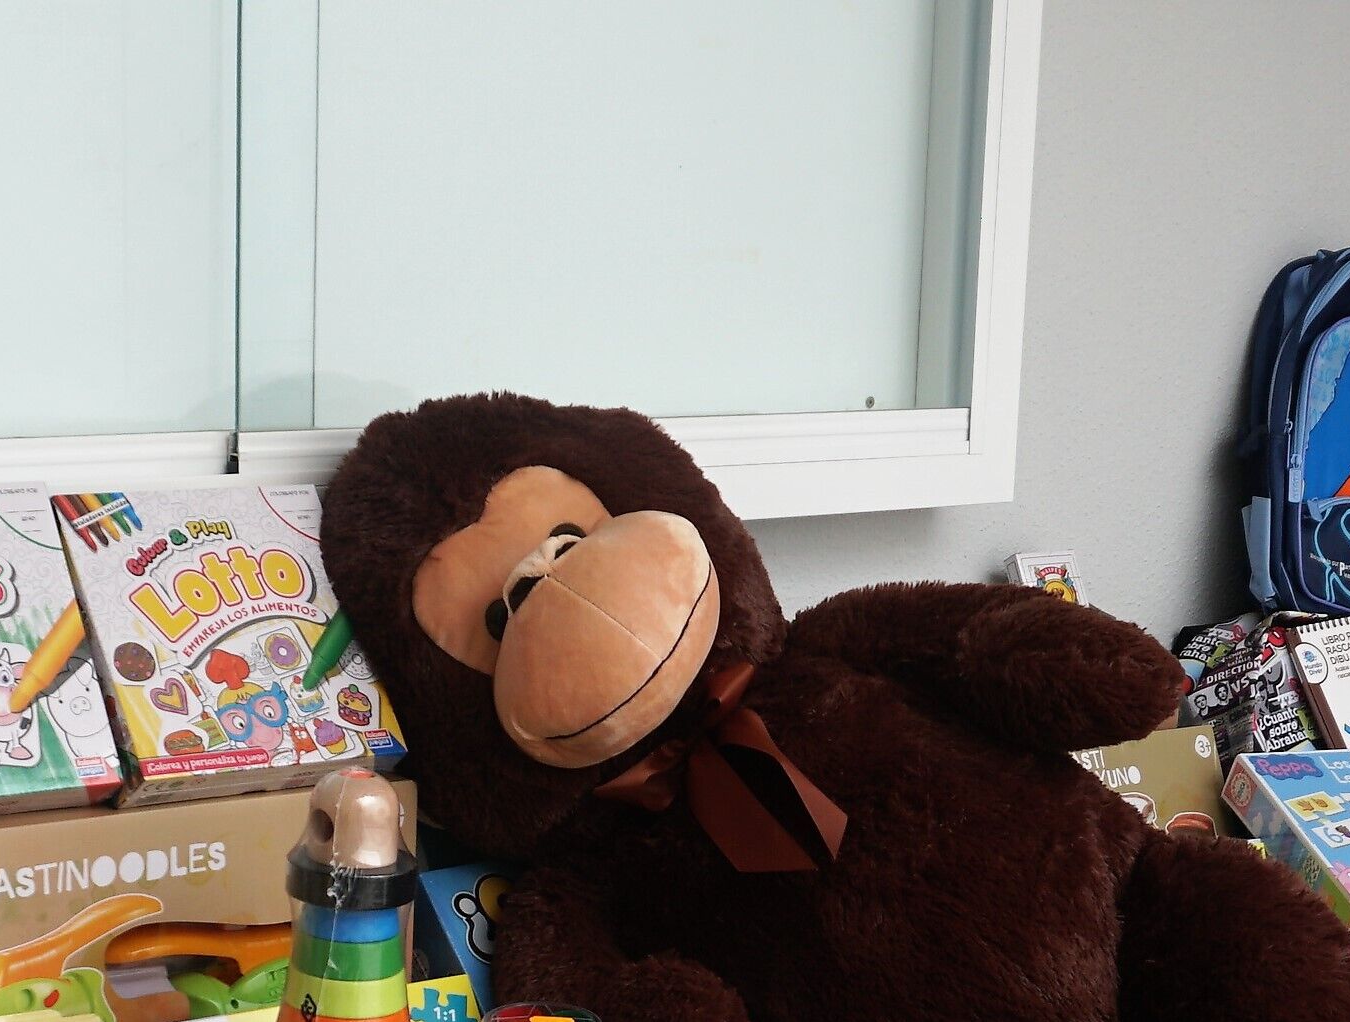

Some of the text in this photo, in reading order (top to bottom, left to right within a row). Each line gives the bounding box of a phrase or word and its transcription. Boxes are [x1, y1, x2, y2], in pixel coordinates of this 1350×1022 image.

[126, 518, 233, 577] Colour & Play
[129, 546, 306, 643] Lotto
[183, 601, 319, 658] EMPAREJA LOS ALIMENTOS
[1321, 633, 1345, 646] LIBRO
[1206, 660, 1262, 685] DIRECTION
[1230, 676, 1251, 693] VS
[1269, 720, 1299, 739] sobre
[189, 753, 237, 771] personaliza
[237, 755, 245, 764] tu
[1254, 757, 1318, 779] Peppa
[1320, 756, 1350, 771] Los
[434, 1004, 460, 1022] 1:1
